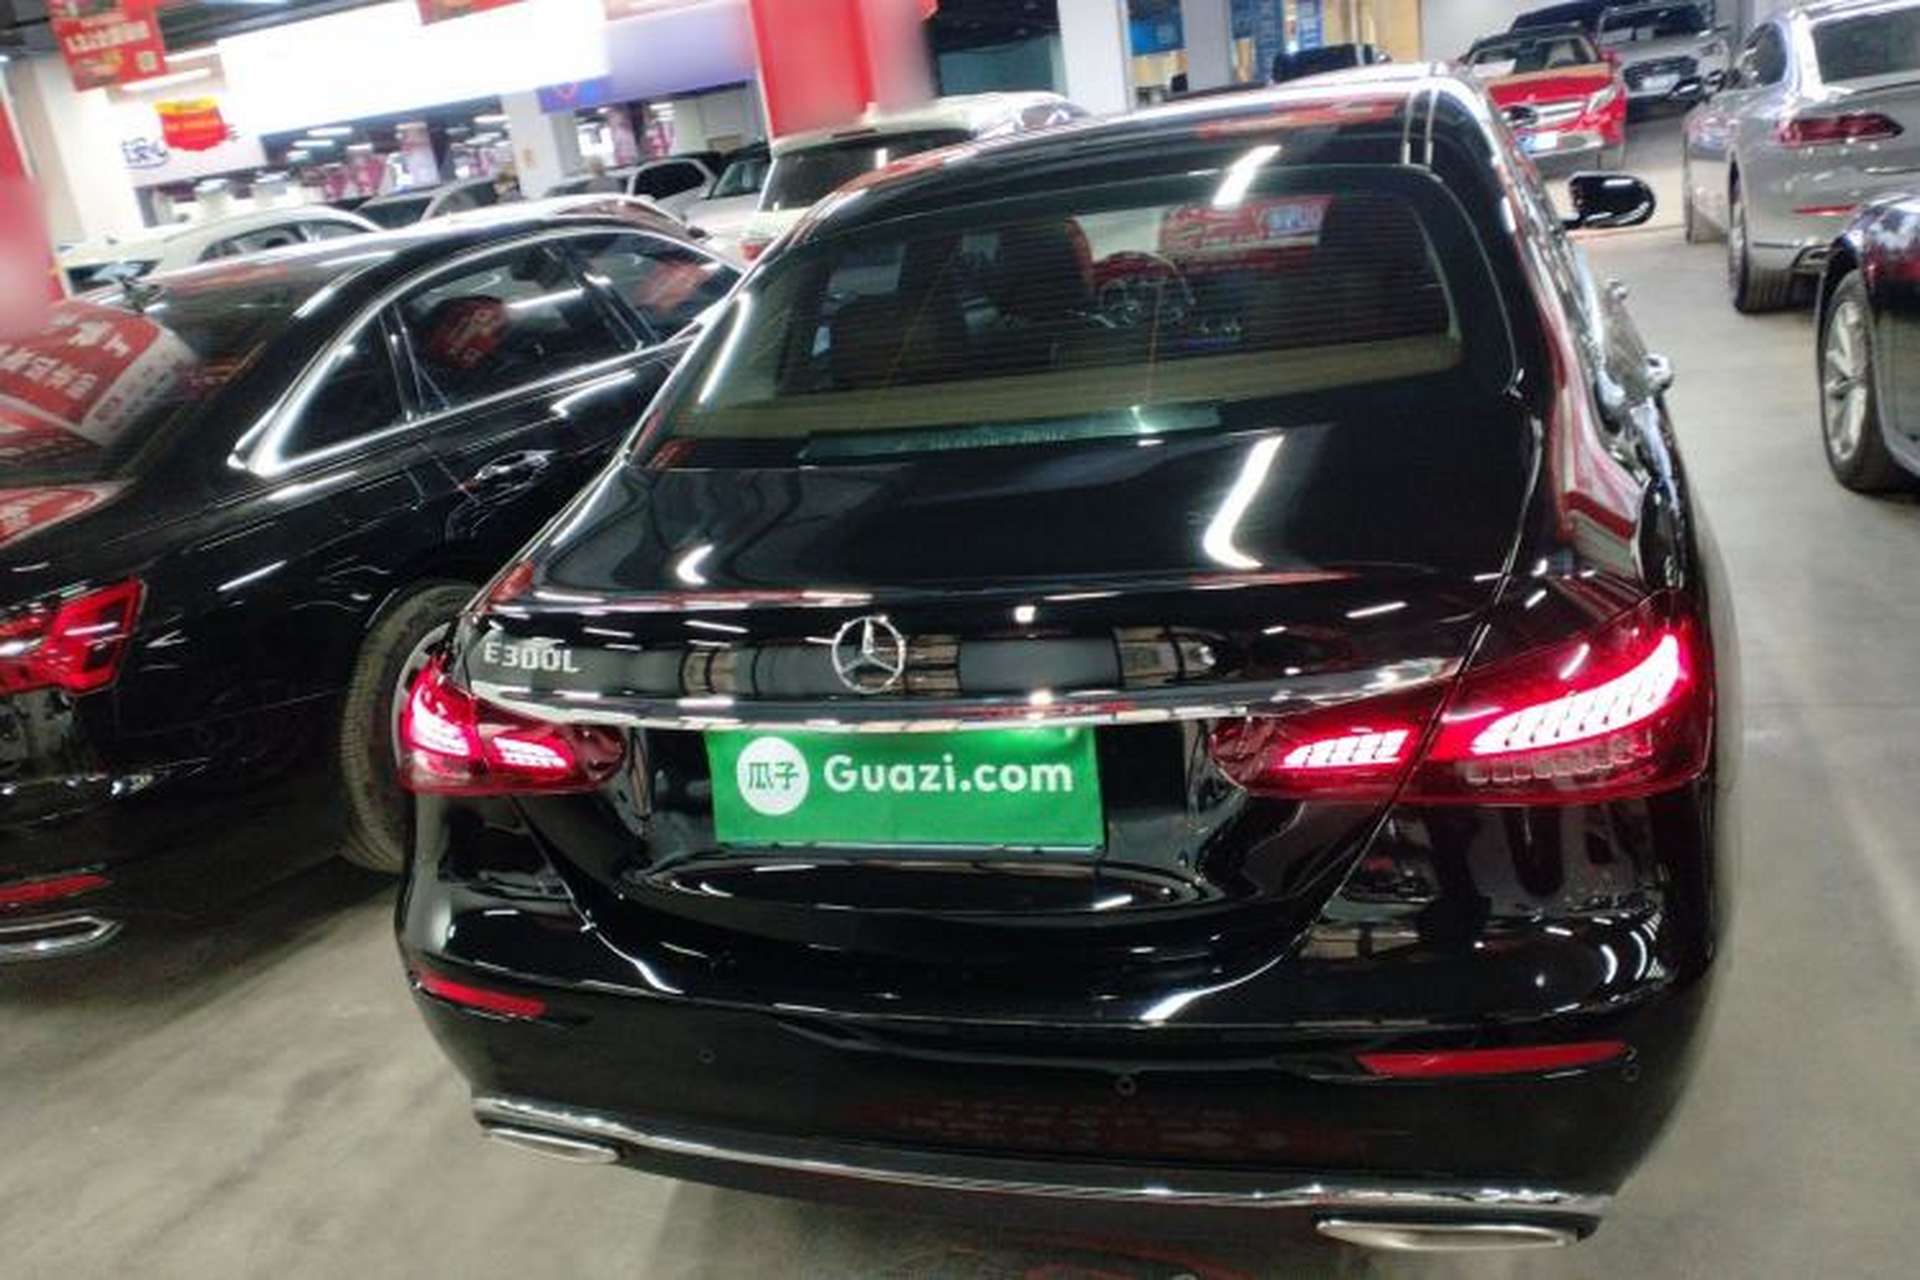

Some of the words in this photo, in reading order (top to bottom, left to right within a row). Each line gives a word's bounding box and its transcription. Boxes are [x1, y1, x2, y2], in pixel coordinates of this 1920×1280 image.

[483, 641, 581, 673] E300L
[748, 760, 799, 791] 瓜子
[823, 753, 1074, 792] Guazi.com
